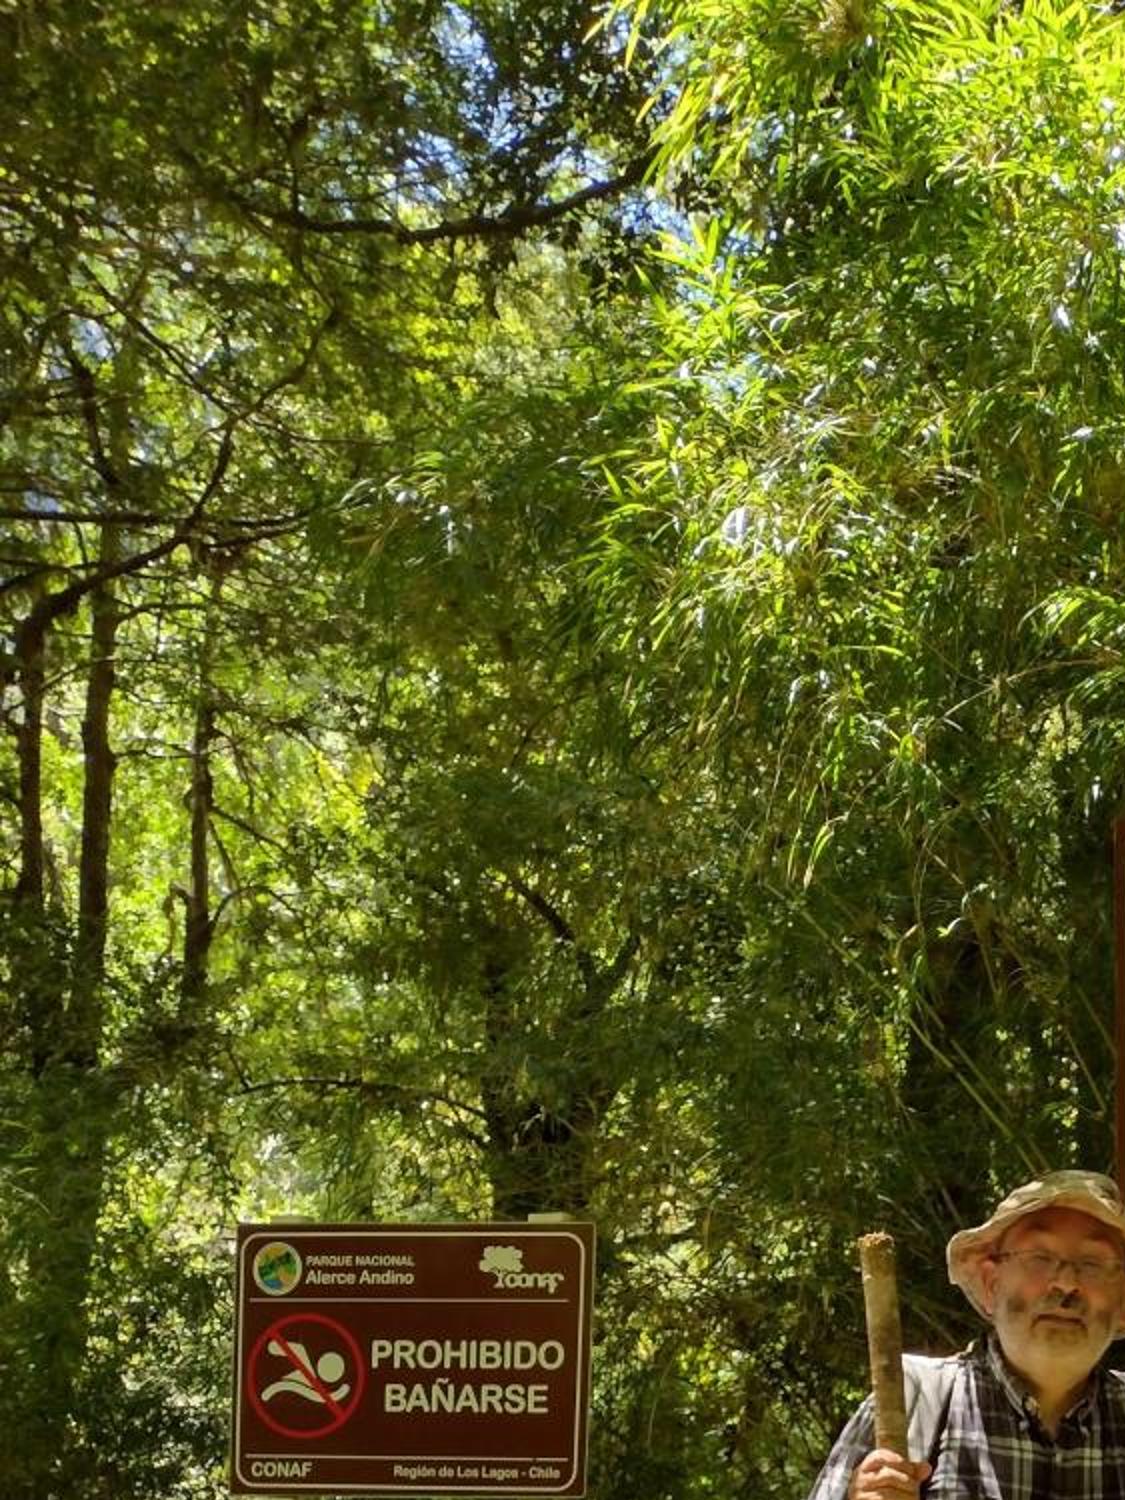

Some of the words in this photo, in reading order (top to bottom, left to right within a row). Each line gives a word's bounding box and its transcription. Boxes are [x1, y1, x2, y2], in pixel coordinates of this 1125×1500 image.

[305, 1255, 353, 1267] PARQUE
[354, 1254, 416, 1267] NACIONAL
[304, 1269, 357, 1285] Alerce
[358, 1269, 415, 1285] Andino
[371, 1339, 565, 1371] PROHIBIDO
[384, 1377, 549, 1415] BAÑARSE
[250, 1461, 313, 1478] CONAF
[393, 1464, 437, 1481] Región
[437, 1465, 455, 1478] de
[456, 1465, 480, 1479] Los
[480, 1465, 519, 1481] Lagos
[527, 1465, 561, 1479] Chile
